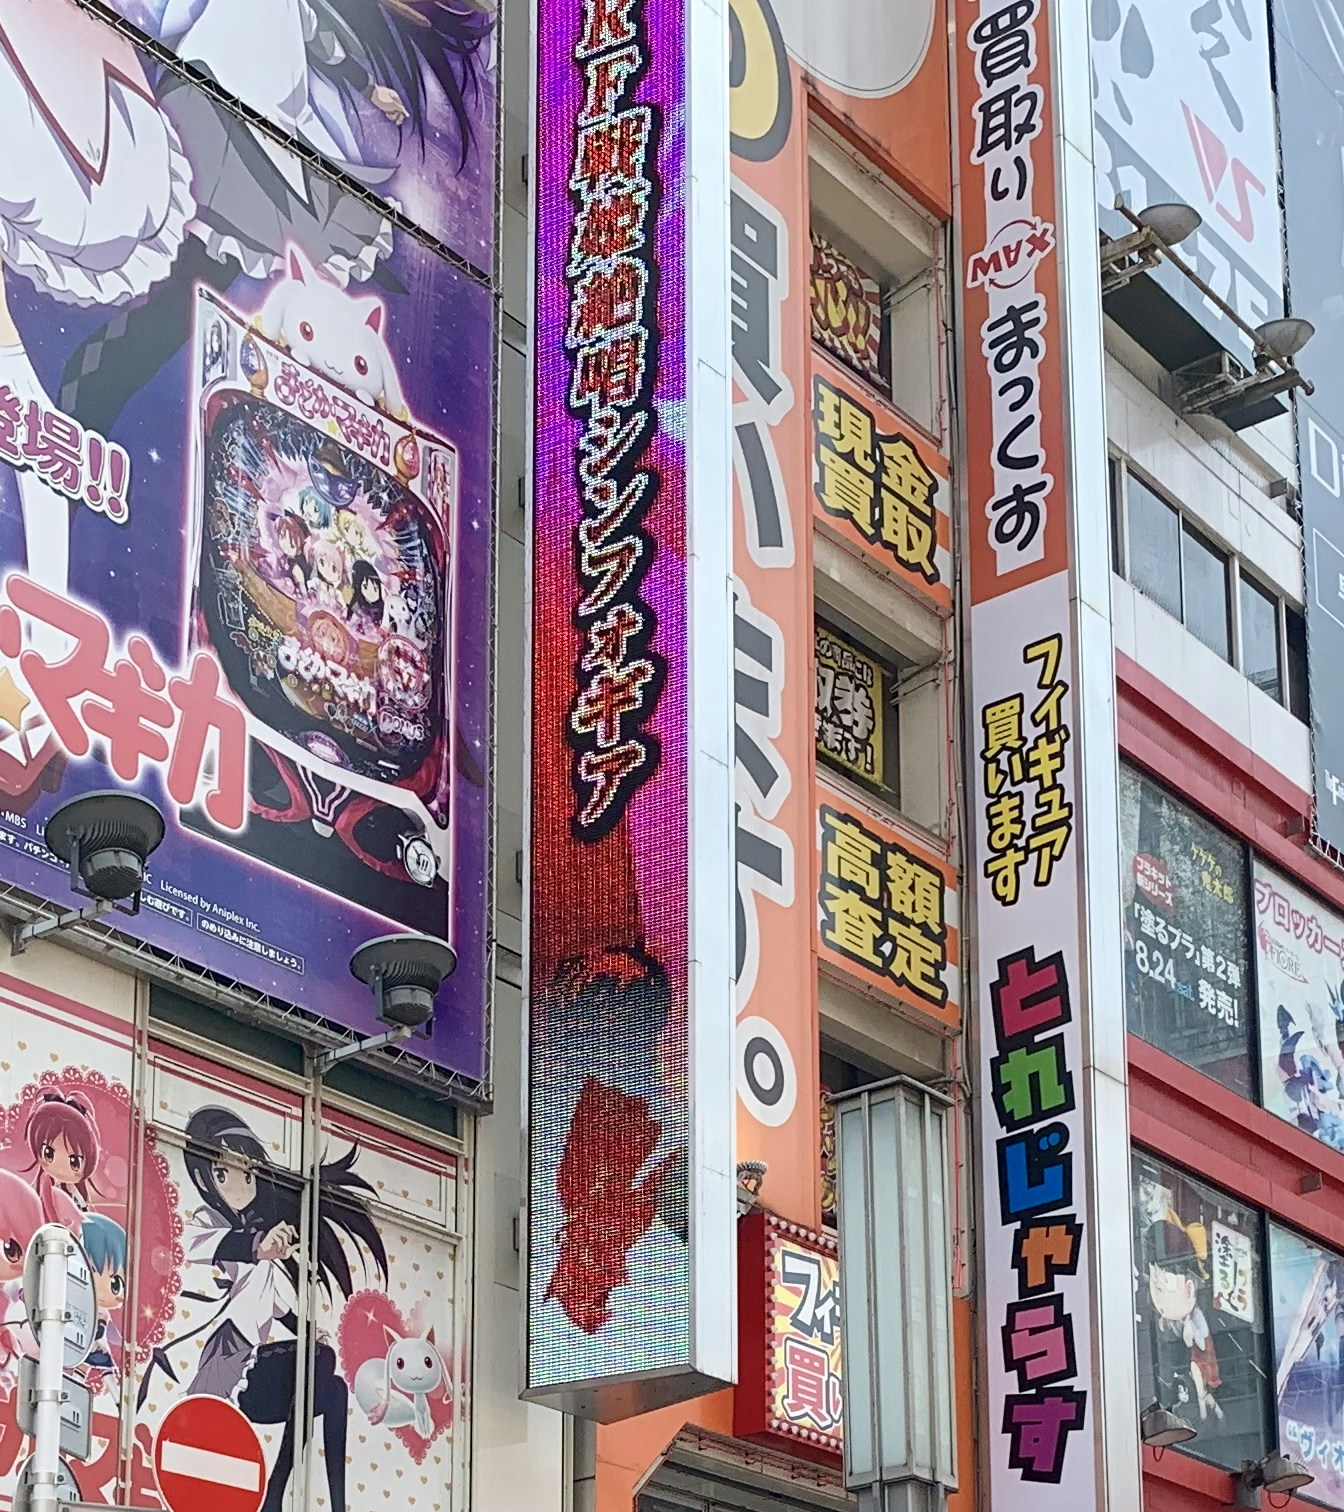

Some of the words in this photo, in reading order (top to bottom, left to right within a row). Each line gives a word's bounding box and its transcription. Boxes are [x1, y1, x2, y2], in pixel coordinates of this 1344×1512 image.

[987, 299, 1048, 553] まっくす
[982, 696, 1026, 908] 買います
[1023, 632, 1072, 888] フィギュア
[990, 944, 1086, 1484] とれじゃらす
